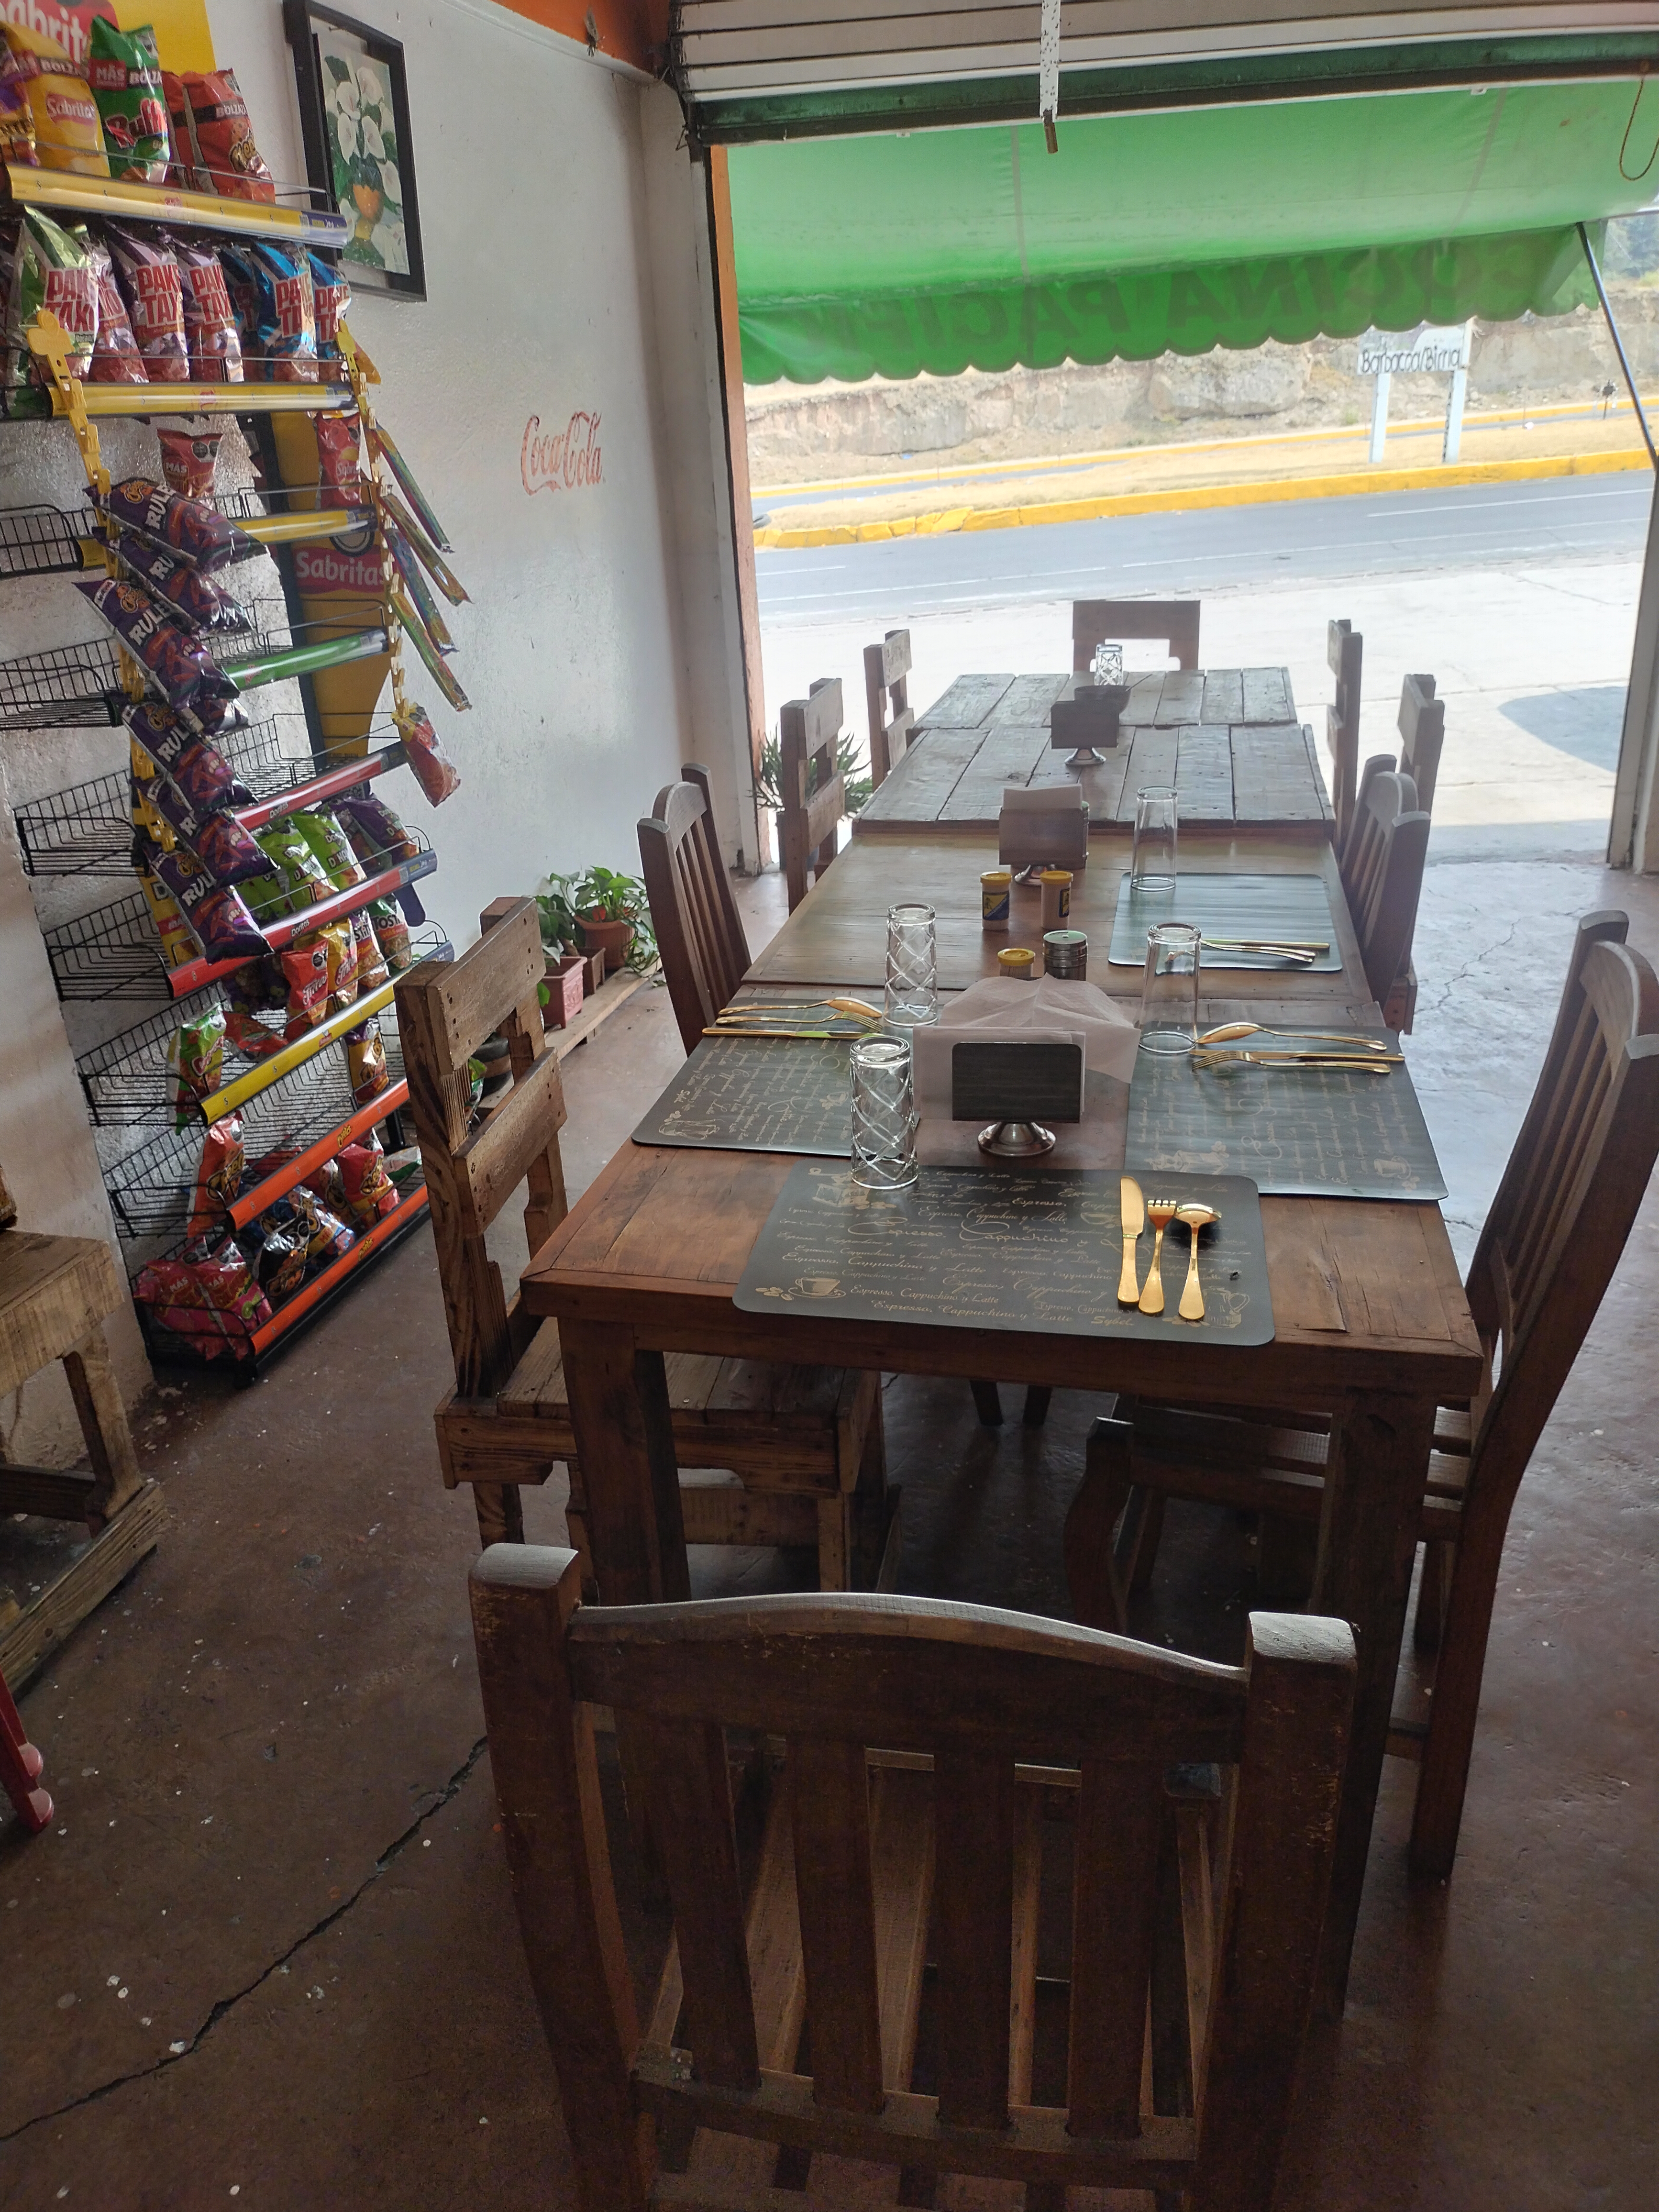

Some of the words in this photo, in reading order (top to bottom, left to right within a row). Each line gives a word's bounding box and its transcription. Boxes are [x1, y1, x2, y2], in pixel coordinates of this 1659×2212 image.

[47, 269, 96, 301] PAK
[291, 918, 310, 937] Doritos
[900, 1288, 958, 1300] Cappuchino
[972, 1293, 999, 1304] Latte
